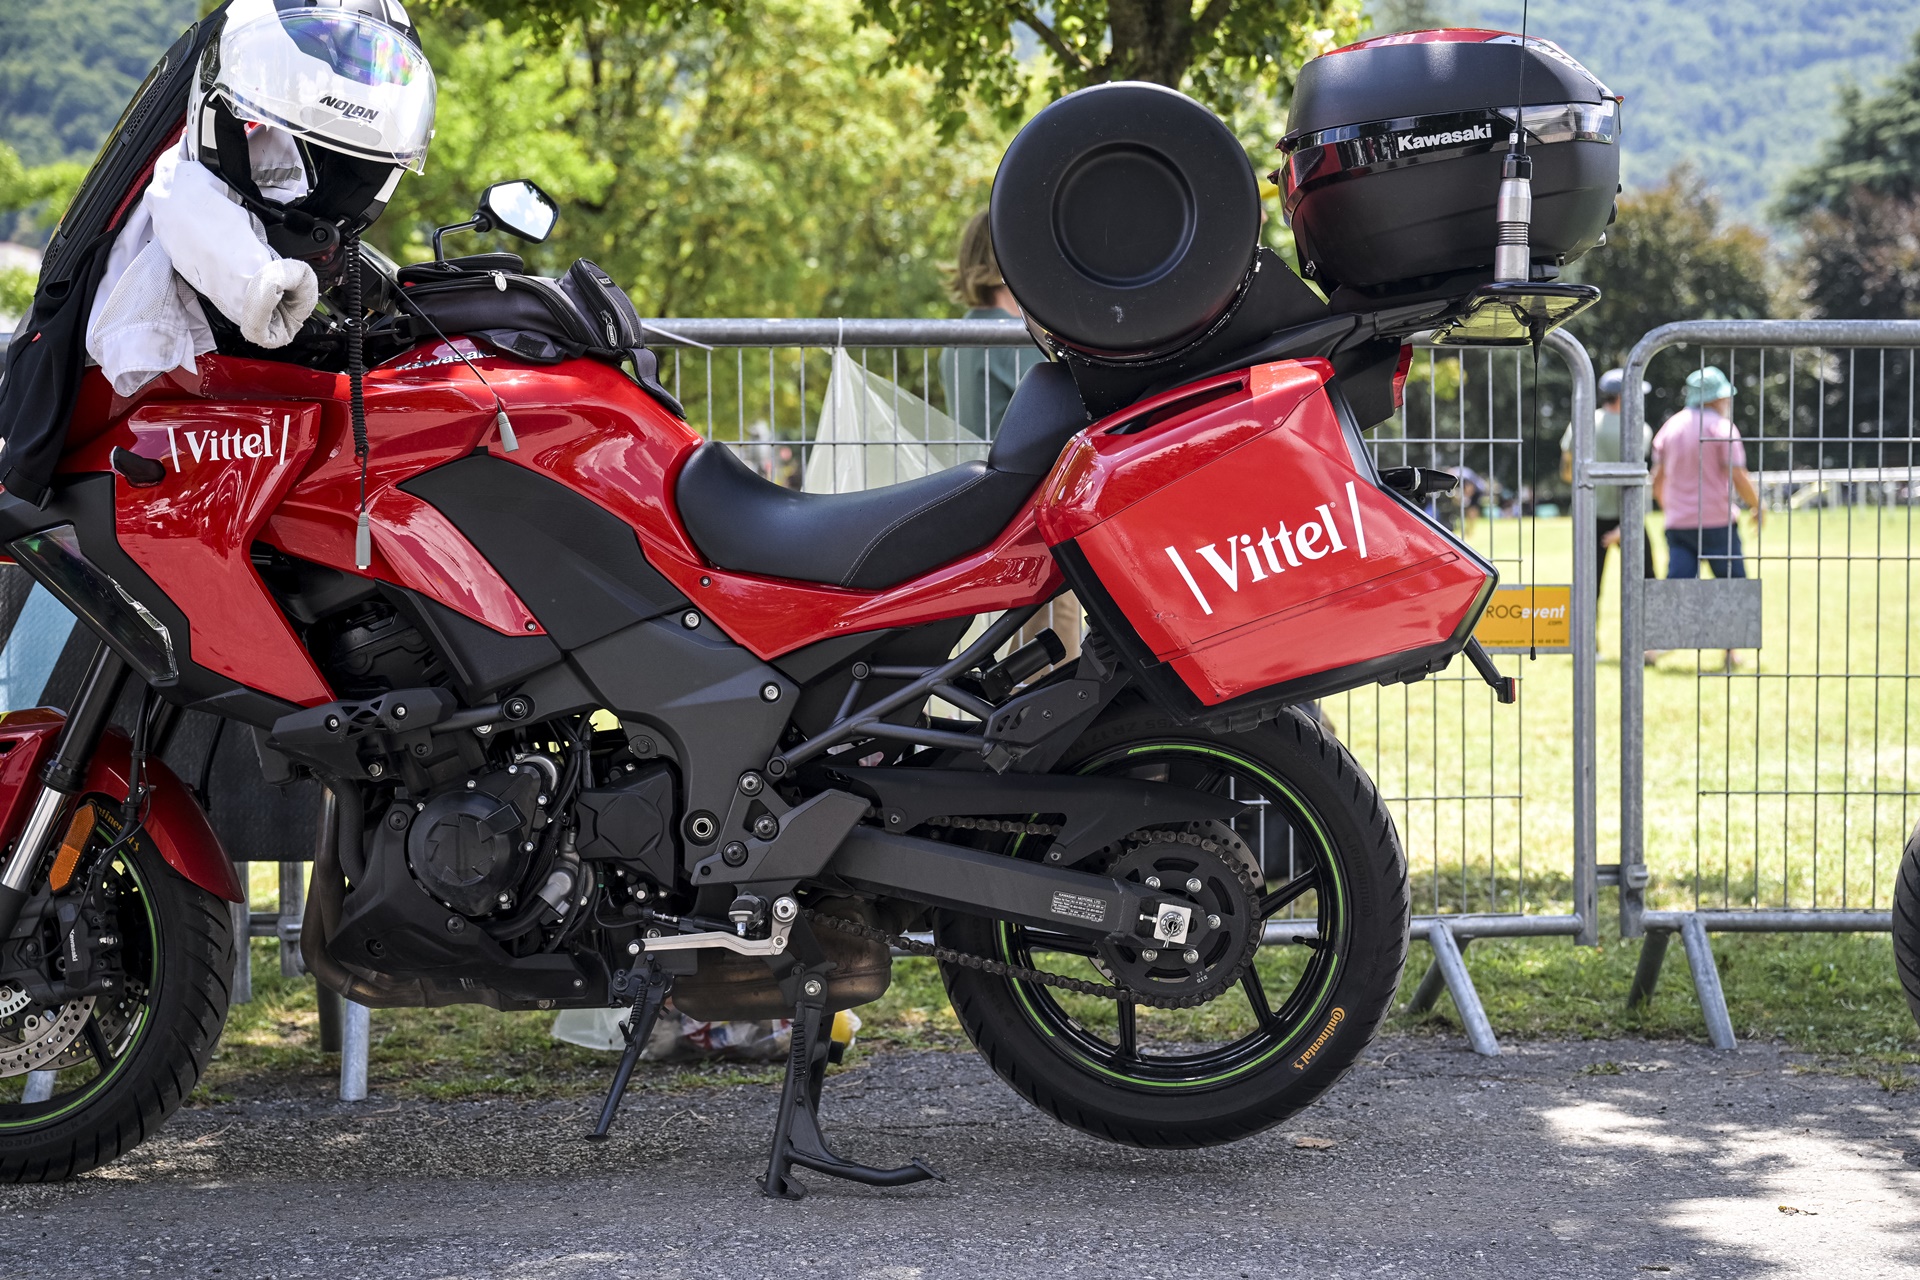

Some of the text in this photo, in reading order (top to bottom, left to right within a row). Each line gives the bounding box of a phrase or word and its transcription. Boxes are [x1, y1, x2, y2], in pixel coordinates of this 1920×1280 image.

[319, 95, 379, 121] NOLAN
[1397, 123, 1492, 151] Kawasaki
[184, 425, 273, 463] Vittel
[1195, 503, 1347, 592] Vittel
[1486, 604, 1565, 619] ROGevent
[1300, 1007, 1345, 1065] Continental
